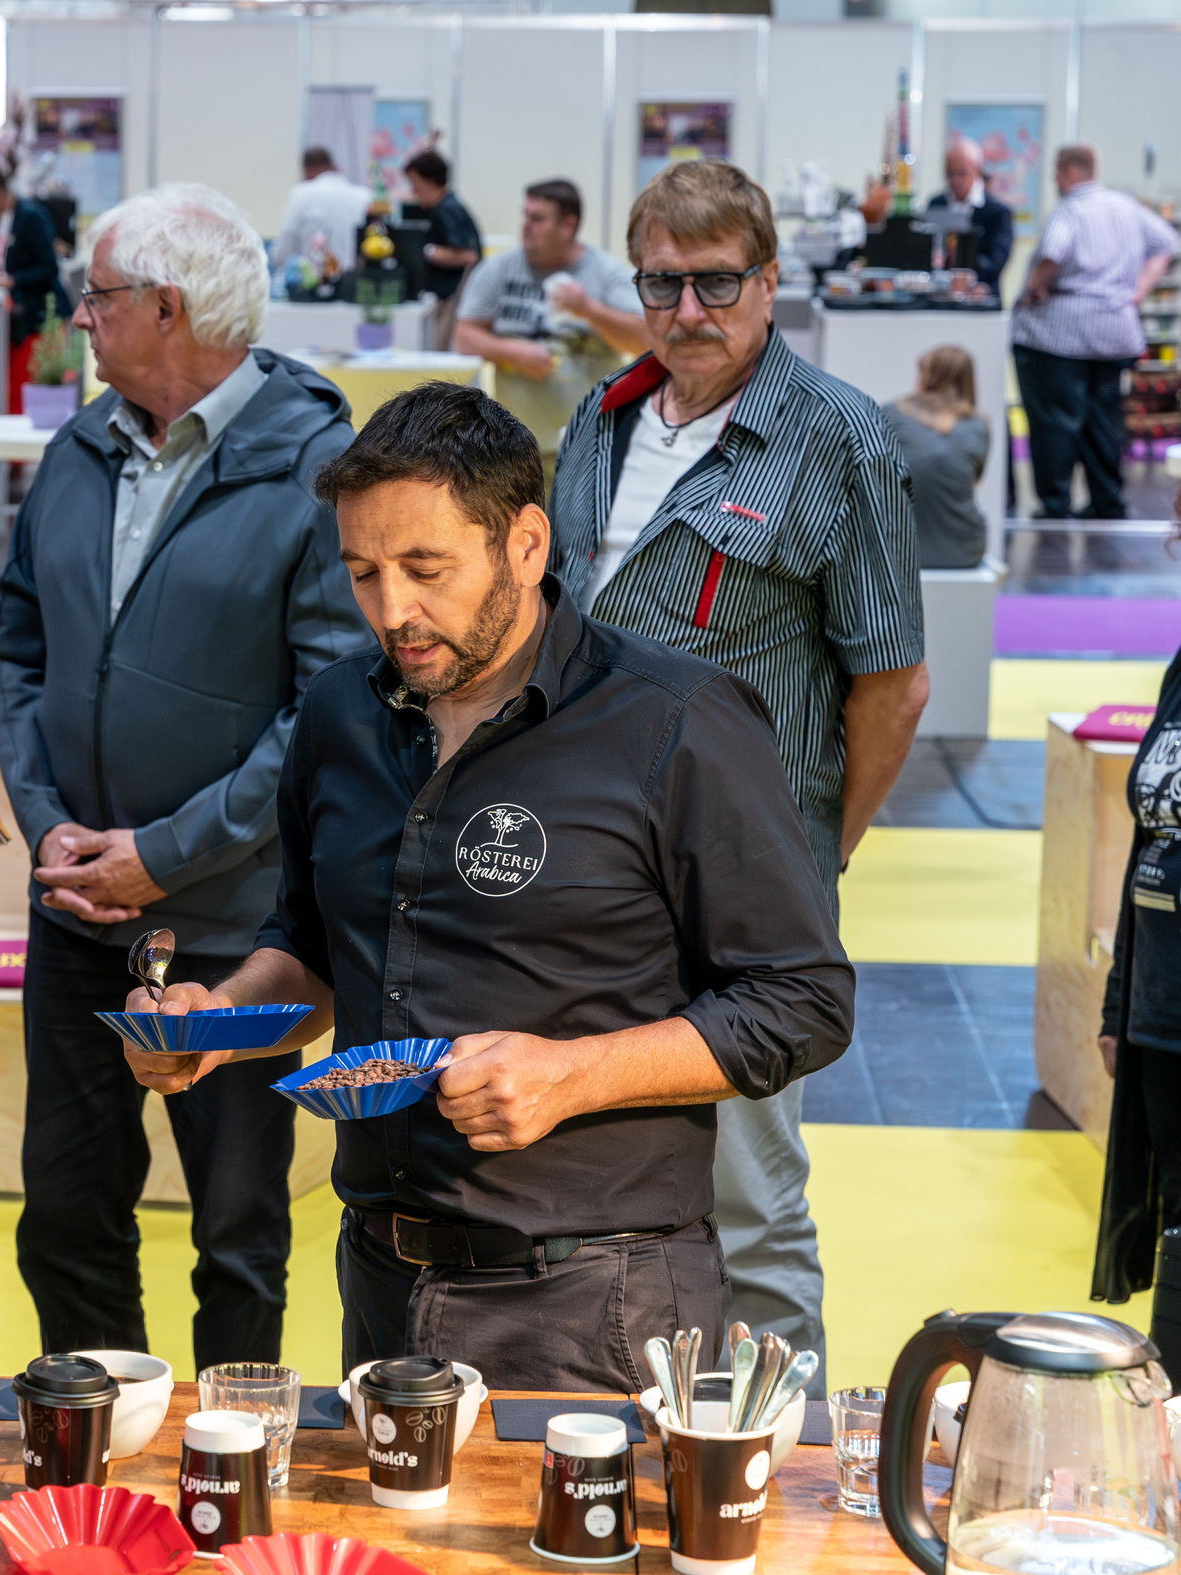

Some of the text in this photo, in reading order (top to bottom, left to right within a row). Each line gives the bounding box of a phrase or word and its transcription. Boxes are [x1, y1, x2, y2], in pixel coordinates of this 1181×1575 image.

[459, 846, 538, 871] RÖSTEREI
[465, 861, 523, 883] Arabica
[368, 1448, 418, 1468] rnold's
[181, 1473, 241, 1495] arnold's
[564, 1479, 627, 1500] arnold's
